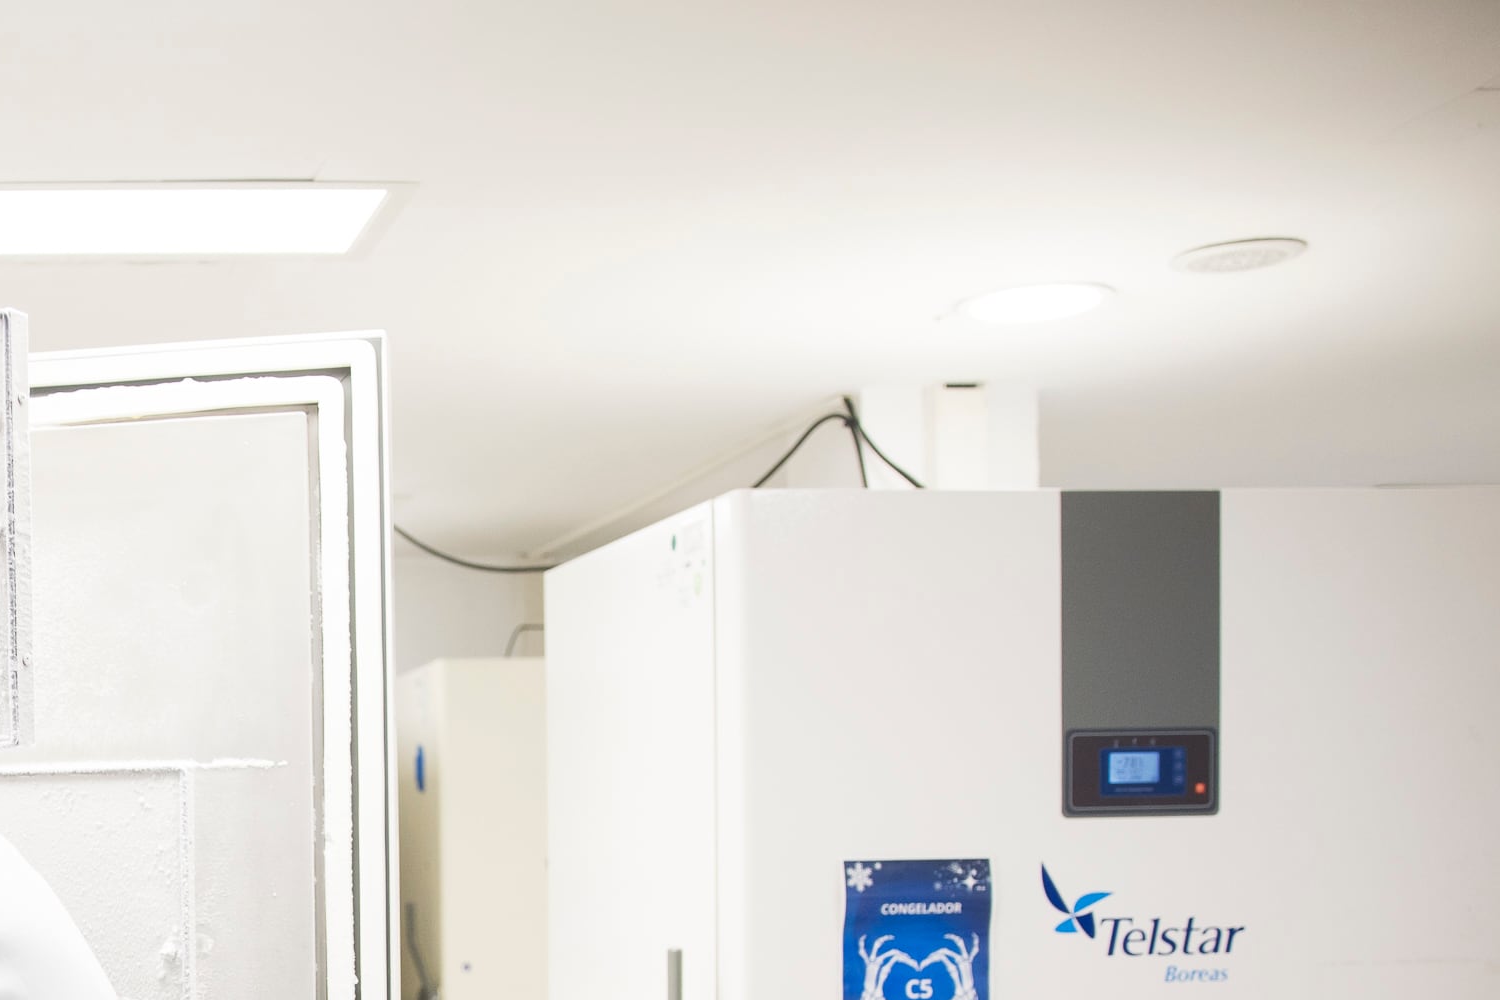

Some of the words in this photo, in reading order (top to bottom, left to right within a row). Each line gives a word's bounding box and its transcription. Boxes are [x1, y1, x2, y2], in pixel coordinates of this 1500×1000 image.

[880, 902, 963, 916] CONGELADOR
[1100, 916, 1246, 956] Telstar
[1164, 965, 1229, 982] Boreas
[905, 979, 934, 1000] C5
